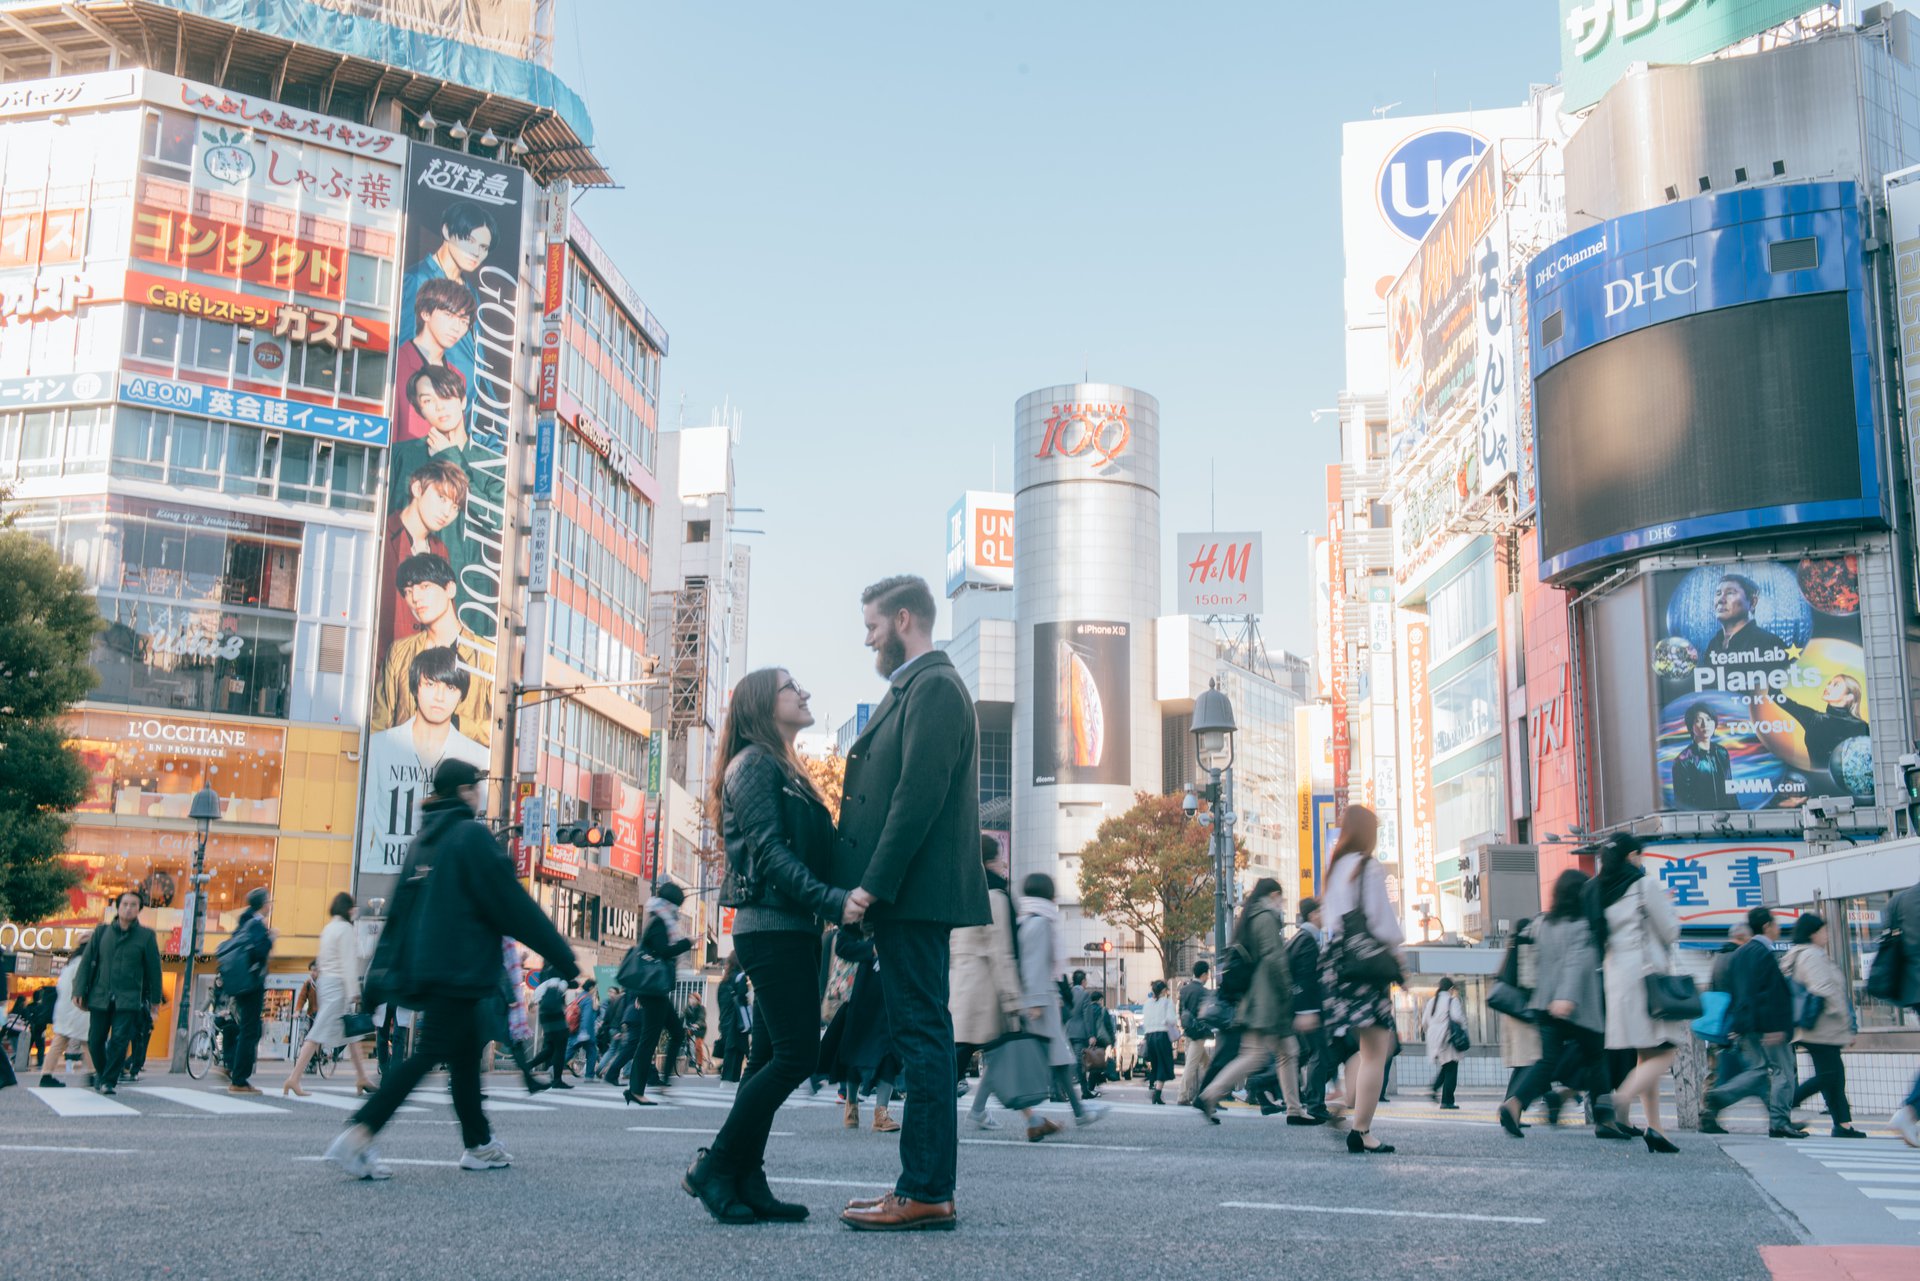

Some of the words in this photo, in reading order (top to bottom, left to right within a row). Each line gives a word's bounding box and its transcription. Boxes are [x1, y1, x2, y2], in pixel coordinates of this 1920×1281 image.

[181, 83, 394, 153] しゃぶしゃぶバイキング
[268, 150, 392, 209] しゃぶ葉
[134, 212, 341, 285] コンタクト
[1420, 164, 1496, 320] WANIMA
[1535, 266, 1557, 289] DHC
[1558, 235, 1608, 272] Channel
[1603, 256, 1698, 319] DHC
[272, 304, 369, 350] ガスト
[1478, 236, 1508, 471] もんじゃ
[468, 265, 518, 482] GOLDEN
[543, 363, 556, 403] ガスト
[128, 379, 194, 407] AEON
[1051, 403, 1128, 416] SHIBUYA
[208, 389, 384, 438] 英会話イーオン
[1034, 412, 1132, 468] 109
[533, 517, 546, 585] 渋谷駅前ビル
[1648, 525, 1677, 541] DHC
[1188, 542, 1252, 585] H&M
[454, 487, 506, 682] EPOCH
[1084, 625, 1112, 635] iPhone
[1709, 646, 1786, 665] teamLab
[1694, 664, 1822, 693] Planets
[1730, 693, 1787, 706] TOKYO
[128, 719, 246, 747] L'OCCITANE
[1727, 720, 1796, 736] TOYOSU
[149, 743, 162, 752] EN
[168, 744, 225, 758] PROVENCE
[389, 765, 421, 783] NEW
[1036, 775, 1055, 783] docomo
[1725, 778, 1806, 795] DMM.com
[615, 818, 637, 848] アコム
[606, 906, 639, 939] LUSH
